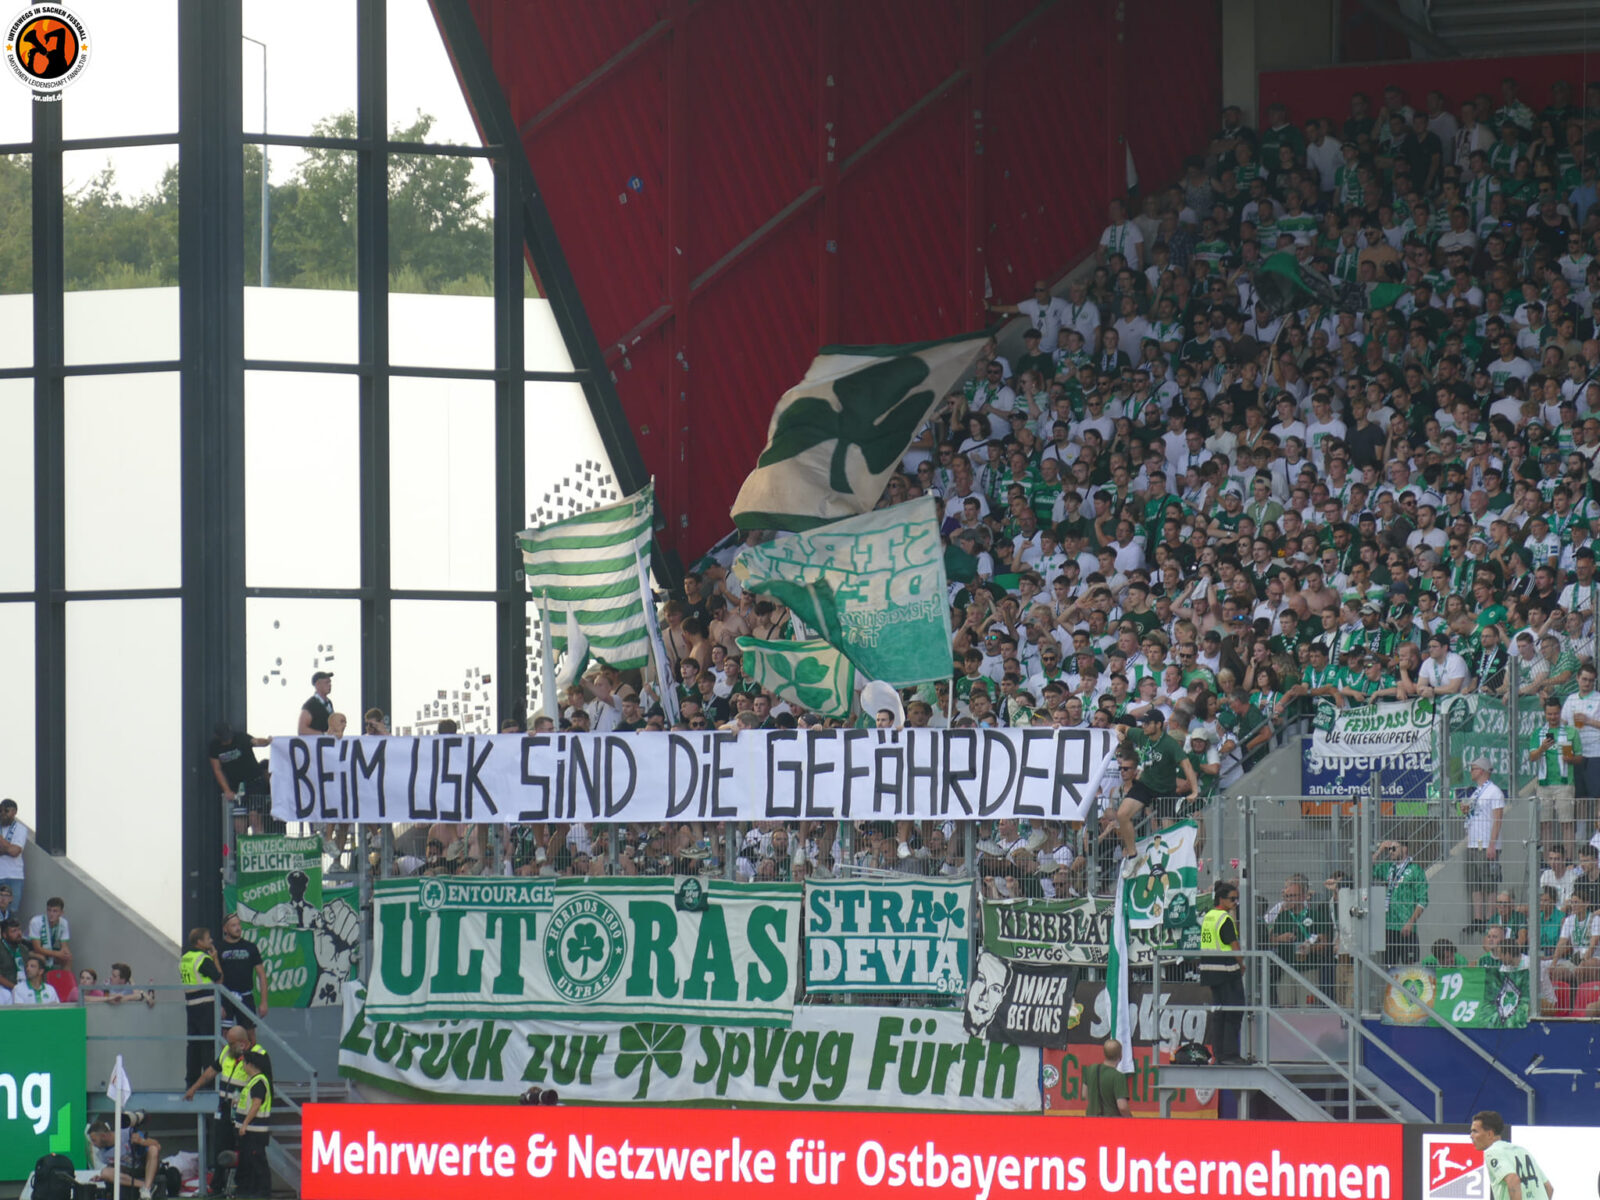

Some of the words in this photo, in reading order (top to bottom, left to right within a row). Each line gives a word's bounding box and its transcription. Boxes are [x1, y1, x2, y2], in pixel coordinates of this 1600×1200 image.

[1344, 710, 1409, 732] FEHLPASS
[409, 738, 499, 821] USK
[241, 838, 318, 854] KENNZEICHNUNGS
[242, 854, 292, 871] PFLICHT
[243, 879, 286, 903] SOFORT!
[447, 885, 554, 903] ENTOURAGE
[549, 900, 598, 940] HORIDOS
[601, 909, 622, 939] 1000
[810, 889, 939, 933] STRA
[809, 938, 963, 983] DEVIA
[1015, 946, 1064, 962] SPVGG
[556, 974, 611, 999] ULTRAS
[1013, 973, 1068, 1006] IMMER
[1440, 973, 1463, 1001] 19
[1006, 1004, 1032, 1031] BEI
[1032, 1006, 1062, 1034] UNS
[1452, 1000, 1480, 1023] 03
[520, 1033, 608, 1085] zur
[693, 1026, 854, 1101] SpVgg
[867, 1016, 1021, 1099] Fürth
[311, 1130, 516, 1177] Mehrwerte
[526, 1133, 557, 1178] &
[567, 1134, 776, 1184] Netzwerke
[786, 1138, 846, 1186] für
[856, 1140, 1087, 1200] Ostbayerns
[1099, 1146, 1391, 1200] Unternehmen
[1515, 1154, 1540, 1190] 44
